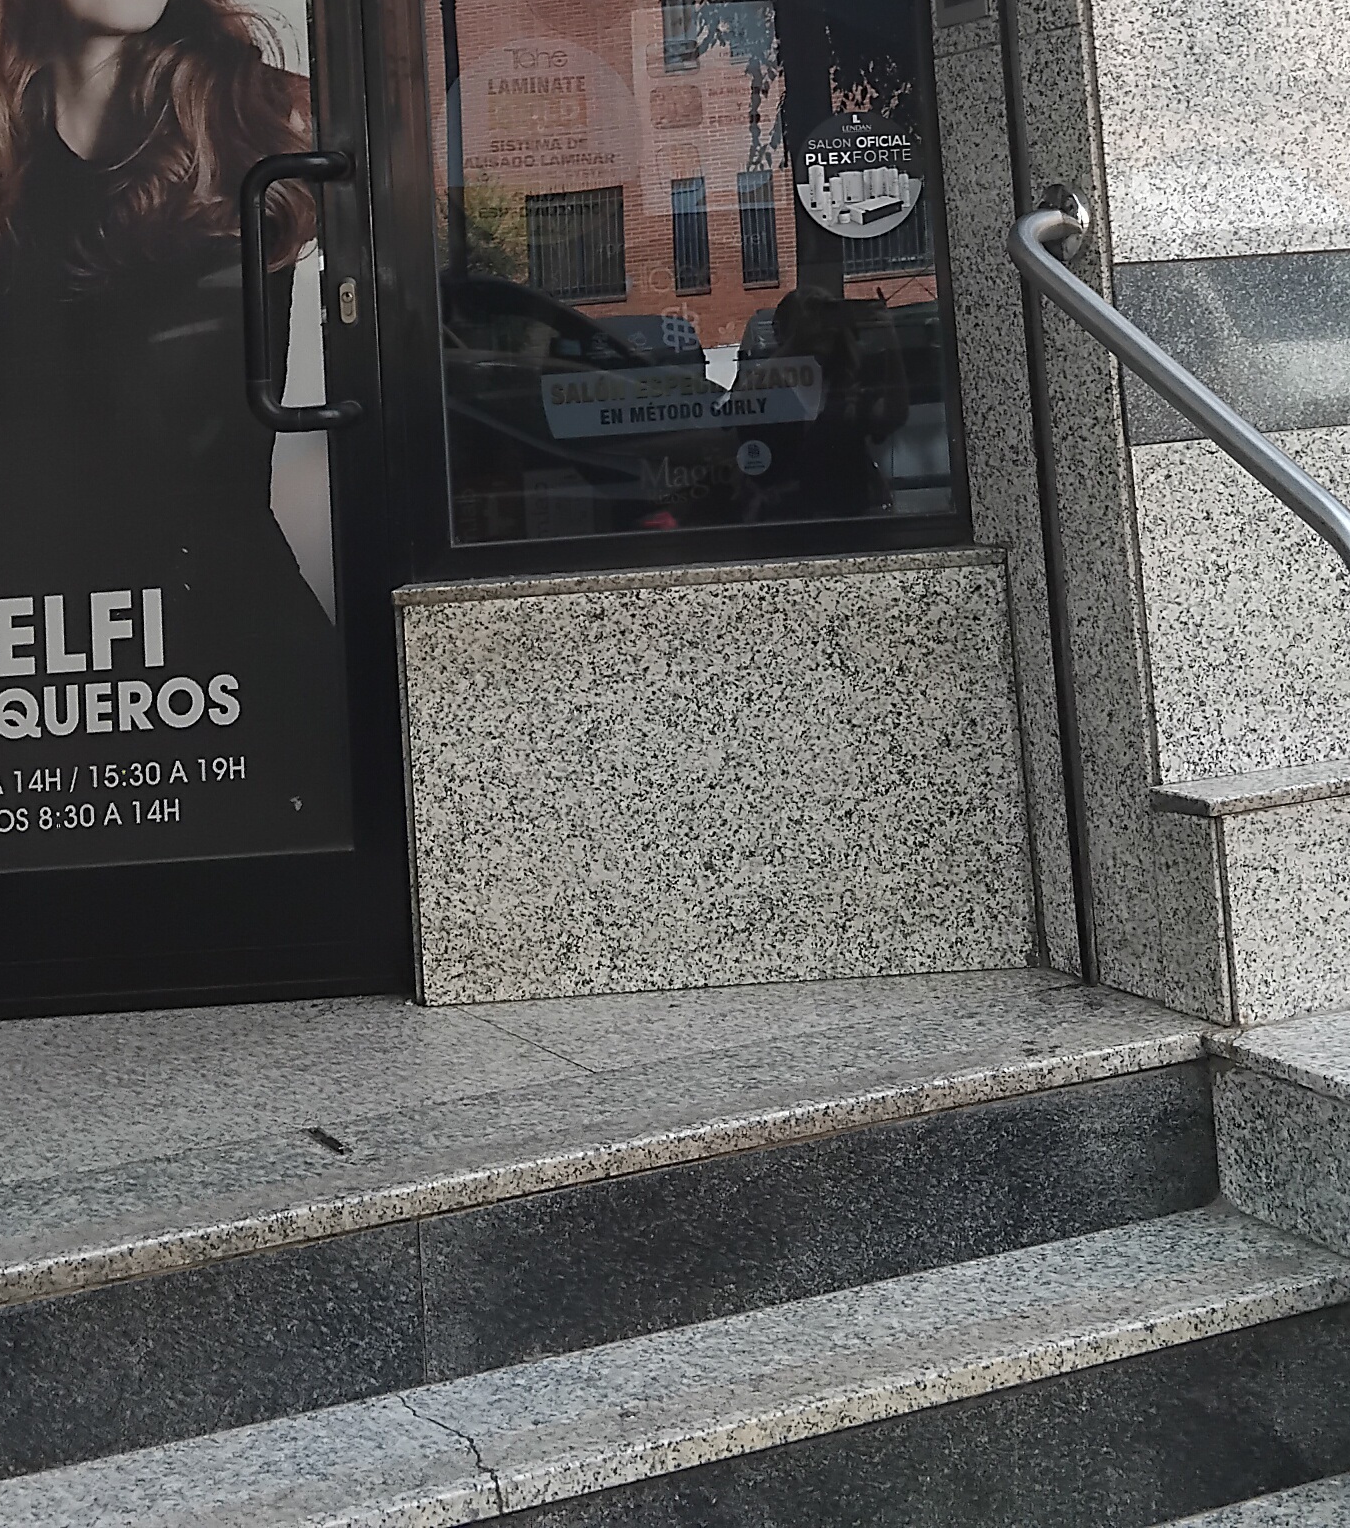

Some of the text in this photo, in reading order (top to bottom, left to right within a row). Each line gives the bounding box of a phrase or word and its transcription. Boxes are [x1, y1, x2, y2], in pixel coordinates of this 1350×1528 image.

[487, 75, 587, 95] LAMINATE
[490, 138, 563, 153] SISTEMA
[807, 134, 911, 150] SALON OFICIAL
[805, 148, 912, 166] PLEXFORTE
[636, 364, 815, 400] ESPECLIZADO
[600, 397, 767, 425] EN MÉTODO CURLY
[13, 768, 62, 793] 14H
[88, 761, 162, 789] 15:30
[169, 760, 189, 785] A
[197, 756, 246, 781] 19H
[38, 804, 95, 831] 8:30
[103, 802, 123, 827] A
[132, 798, 181, 824] 14H
